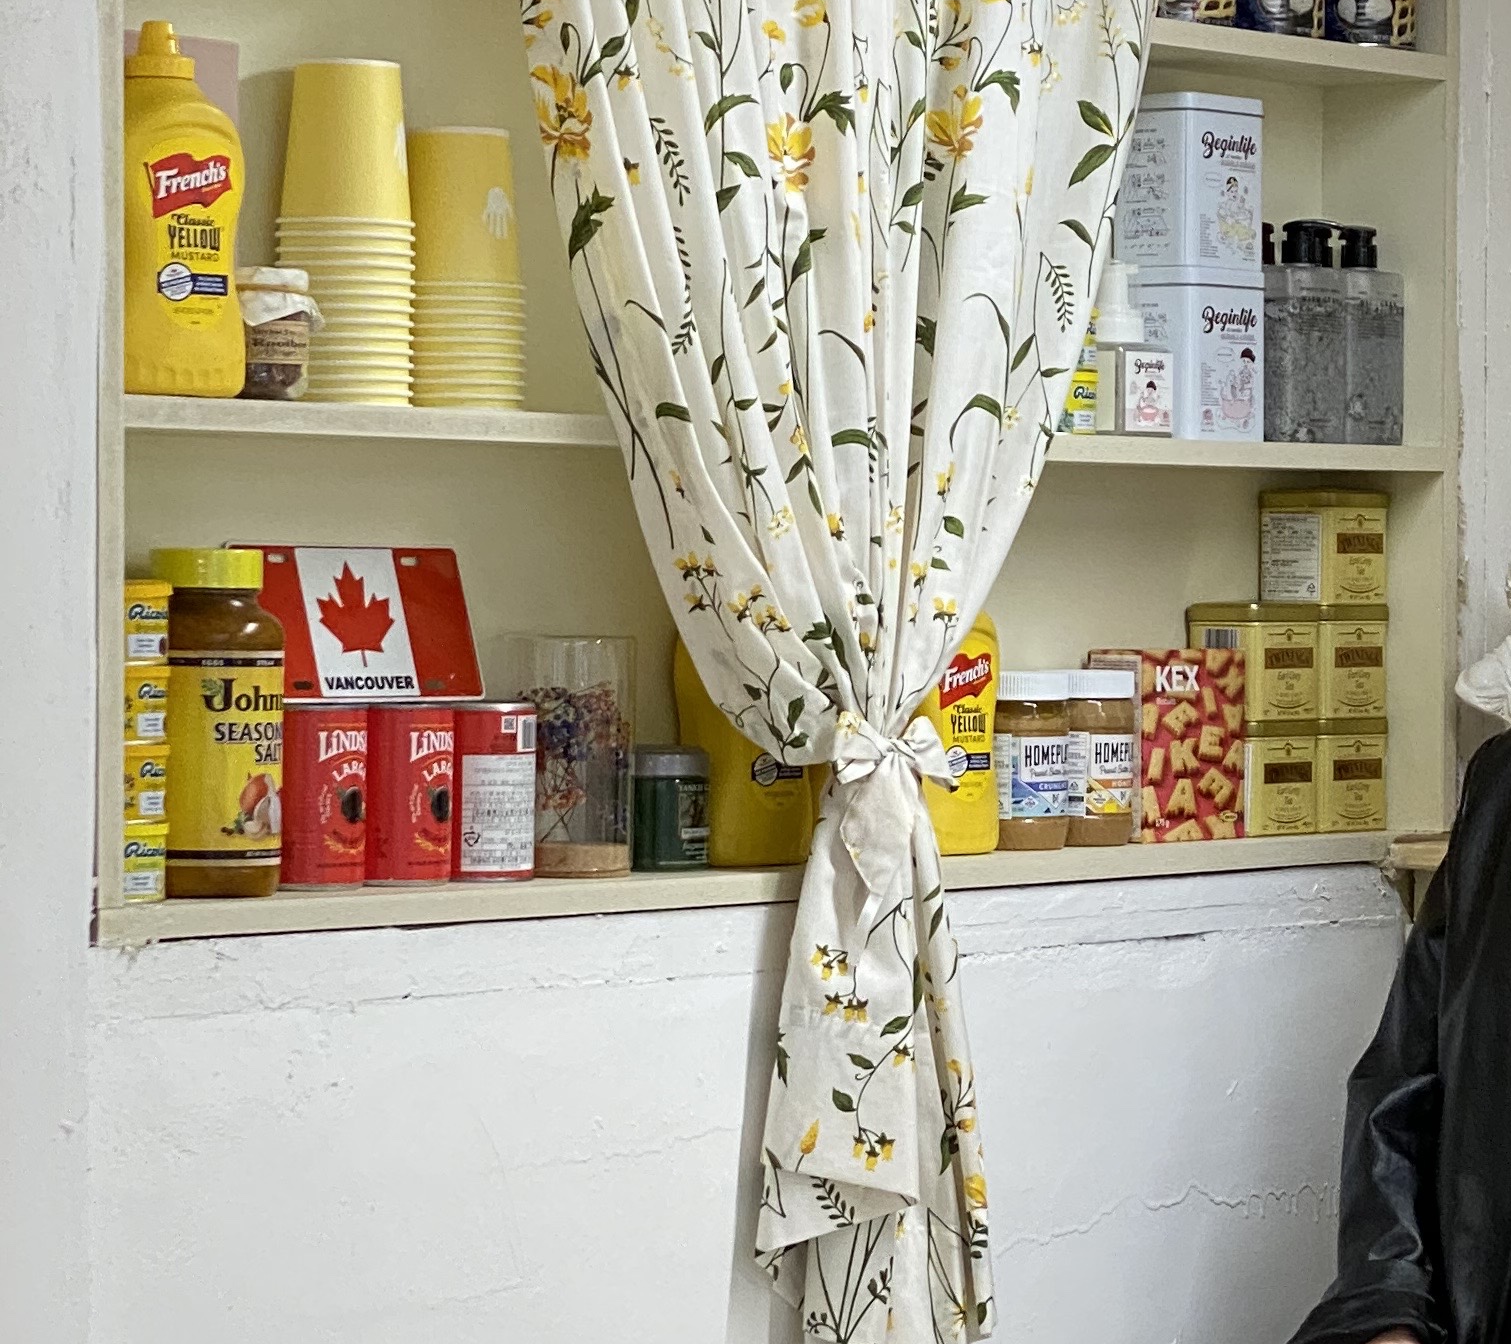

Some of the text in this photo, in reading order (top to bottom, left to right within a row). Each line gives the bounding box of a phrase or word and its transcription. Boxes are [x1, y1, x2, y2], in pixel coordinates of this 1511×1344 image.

[1201, 131, 1257, 160] Beginlife
[156, 160, 227, 199] French's
[171, 213, 214, 226] Classic
[168, 224, 220, 251] YELLOW
[171, 251, 219, 262] MUSTARD
[1202, 305, 1257, 334] Beginlife
[325, 676, 415, 690] VANCOUVER
[943, 658, 989, 693] French's
[1155, 665, 1200, 692] KEX
[950, 714, 986, 734] YELLOW
